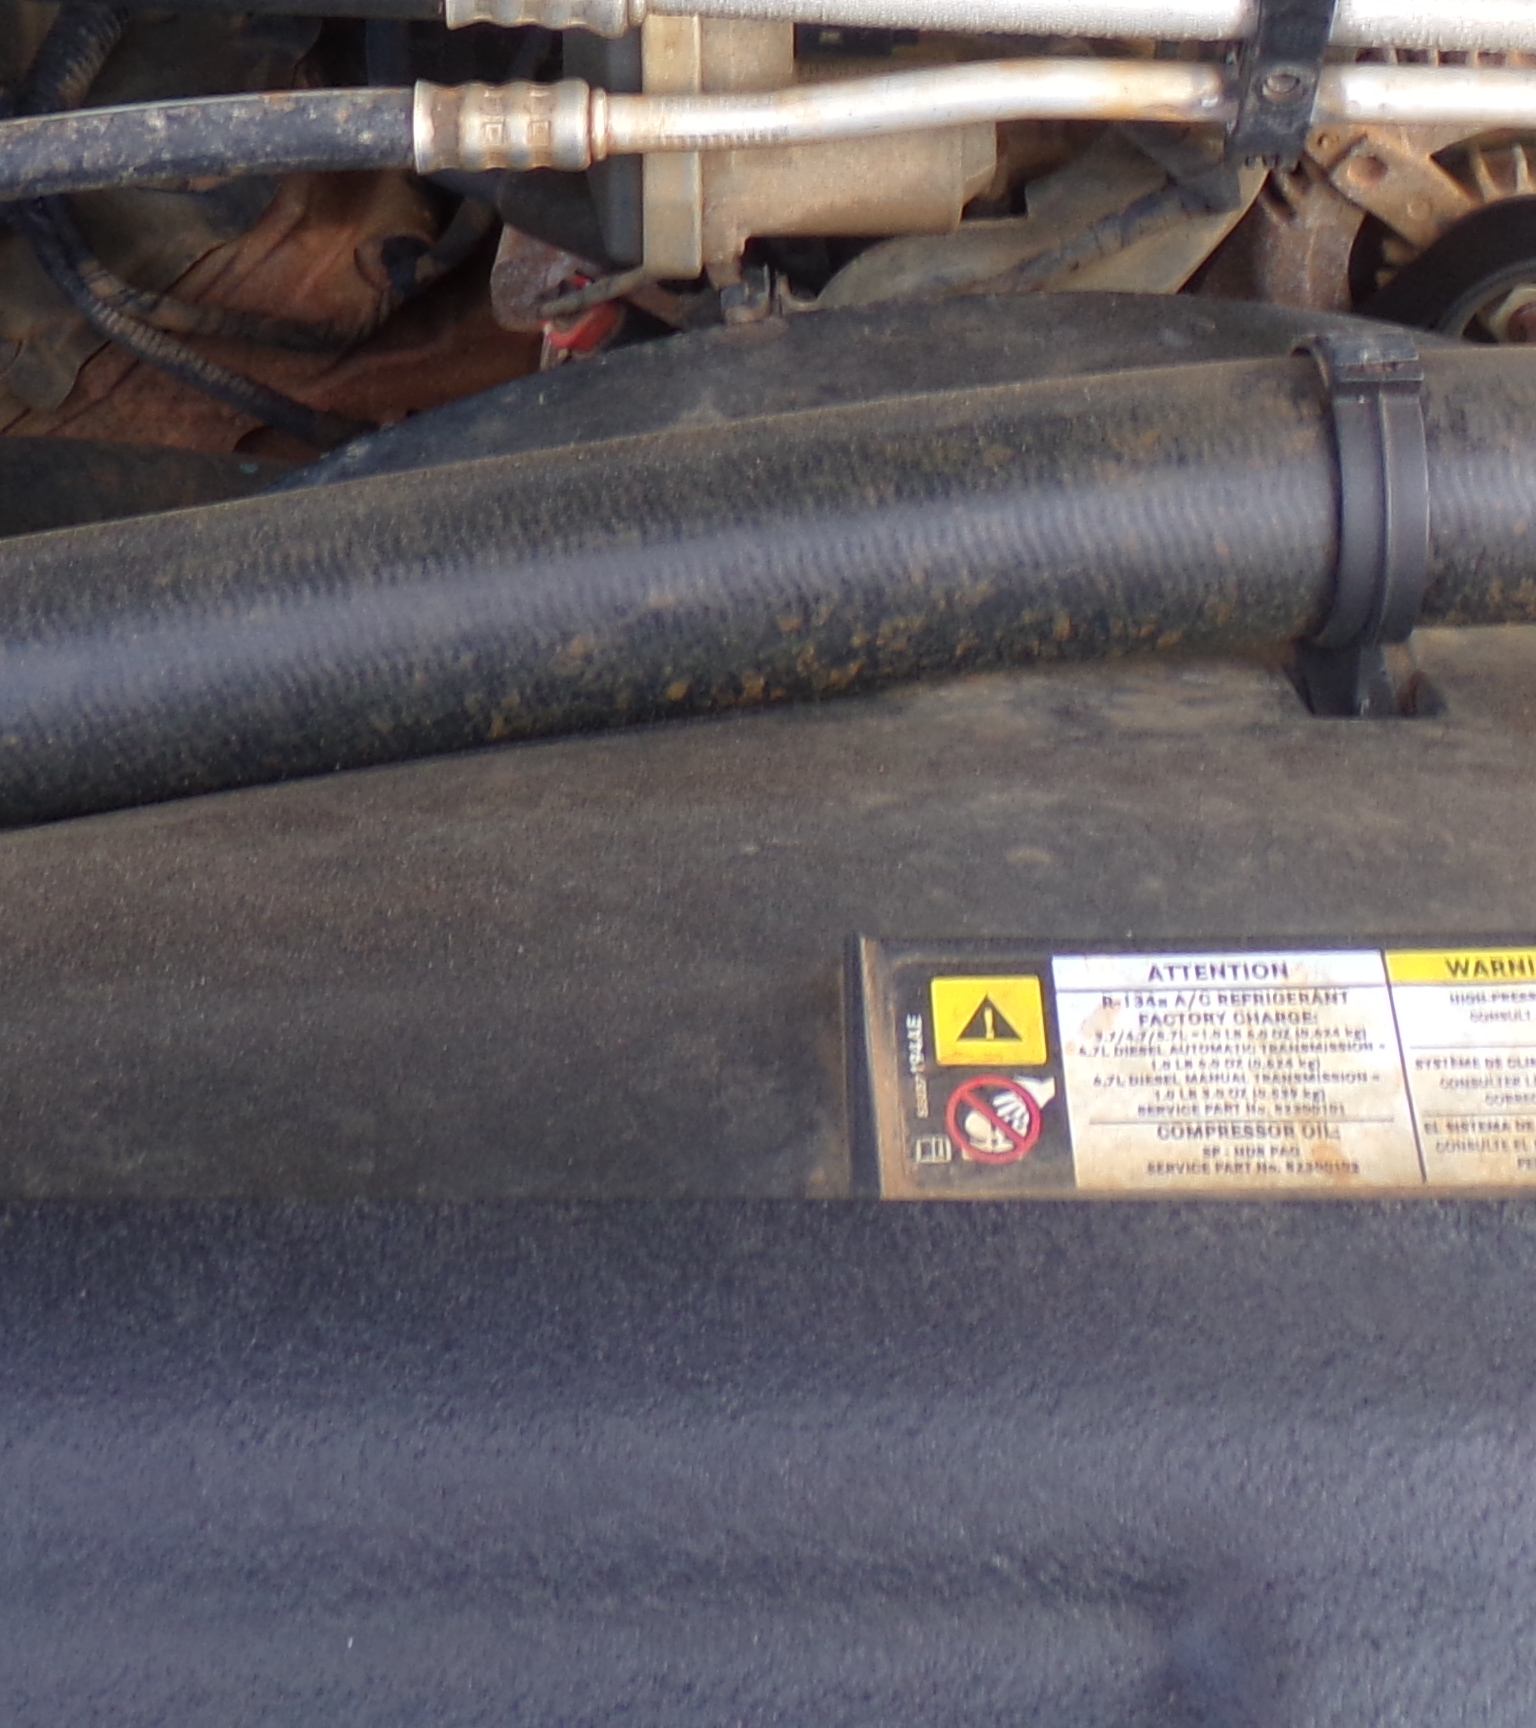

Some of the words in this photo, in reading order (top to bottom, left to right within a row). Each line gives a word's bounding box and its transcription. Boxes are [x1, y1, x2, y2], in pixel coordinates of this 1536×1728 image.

[1148, 960, 1289, 982] ATTENTION
[1175, 991, 1212, 1011] A/C
[1217, 991, 1349, 1008] REFRIGERANT
[1138, 1013, 1226, 1028] FACTORY
[1156, 1123, 1295, 1140] COMPRESSOR
